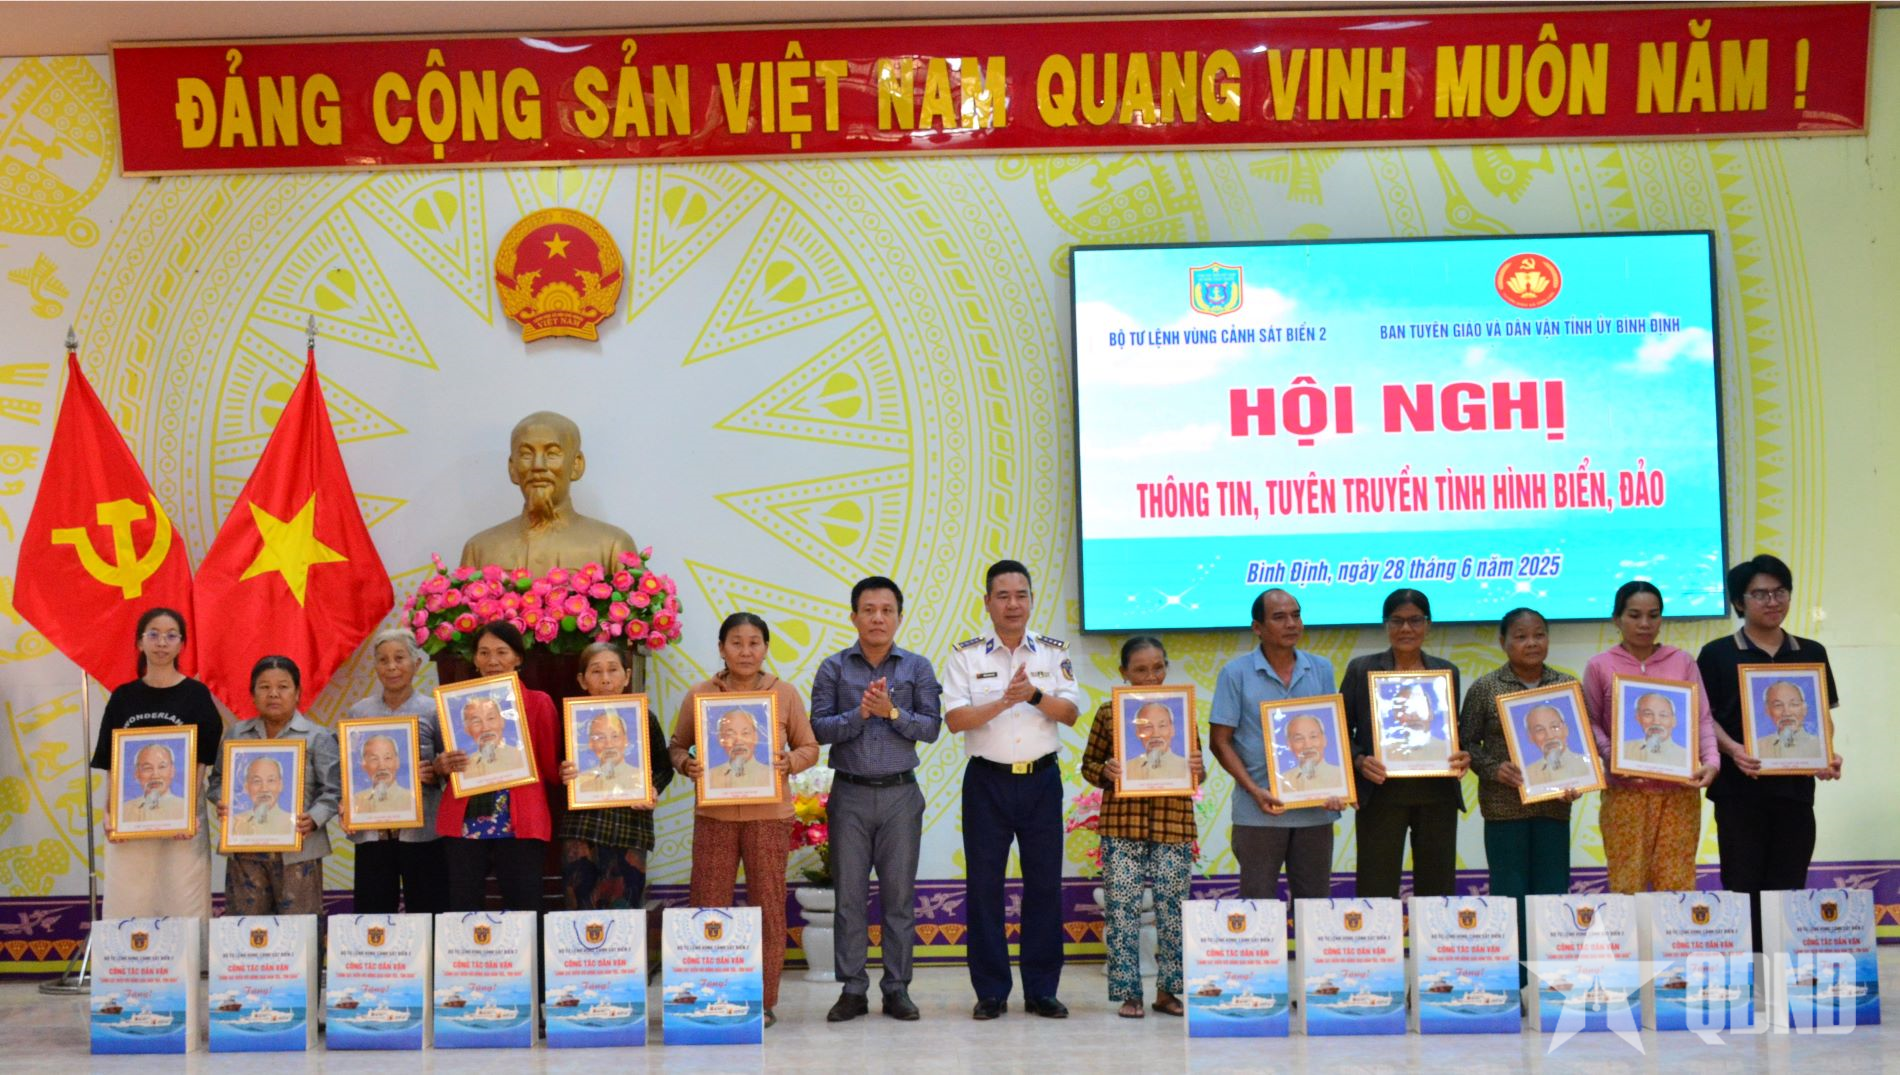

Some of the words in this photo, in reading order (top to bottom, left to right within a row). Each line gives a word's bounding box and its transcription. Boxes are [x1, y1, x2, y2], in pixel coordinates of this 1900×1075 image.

[175, 48, 342, 150] ĐẢNG
[373, 48, 543, 160] CỘNG
[573, 38, 691, 140] SẢN
[717, 40, 849, 150] VIỆT
[877, 55, 1008, 132] NAM
[1036, 48, 1242, 128] QUANG
[1265, 46, 1407, 122] VINH
[1434, 22, 1610, 119] MUÔN
[1635, 18, 1770, 114] NĂM
[1794, 38, 1811, 110] !
[1109, 328, 1126, 350] BỘ
[1130, 330, 1146, 346] TƯ
[1149, 328, 1180, 349] LỆNH
[1184, 326, 1217, 345] VÙNG
[1221, 324, 1255, 344] CẢNH
[1259, 324, 1282, 343] SÁT
[1286, 321, 1316, 342] BIỂN
[1319, 326, 1327, 341] 2
[1380, 325, 1406, 340] BAN
[1409, 321, 1449, 339] TUYÊN
[1453, 320, 1482, 338] GIÁO
[1486, 319, 1502, 337] VÀ
[1506, 318, 1531, 337] DÂN
[1535, 318, 1560, 339] VẬN
[1563, 316, 1592, 335] TỈNH
[1616, 316, 1646, 334] BÌNH
[1649, 317, 1680, 336] ĐỊNH
[1229, 376, 1354, 446] HỘI
[1383, 380, 1564, 441] NGHỊ
[1136, 475, 1210, 519] THÔNG
[1216, 480, 1259, 520] TIN,
[1265, 471, 1337, 515] TUYÊN
[1342, 464, 1429, 513] TRUYỀN
[1435, 467, 1486, 511] TÌNH
[1492, 466, 1547, 509] HÌNH
[1553, 457, 1613, 512] BIỂN,
[1619, 458, 1665, 507] ĐẢO
[1247, 562, 1286, 583] Bình
[1290, 560, 1332, 587] Định,
[1337, 559, 1380, 583] ngày
[1383, 559, 1405, 580] 28
[1409, 558, 1456, 581] tháng
[1461, 558, 1472, 578] 6
[1476, 556, 1513, 578] năm
[1518, 555, 1561, 577] 2025
[123, 711, 184, 729] WONDERLAN
